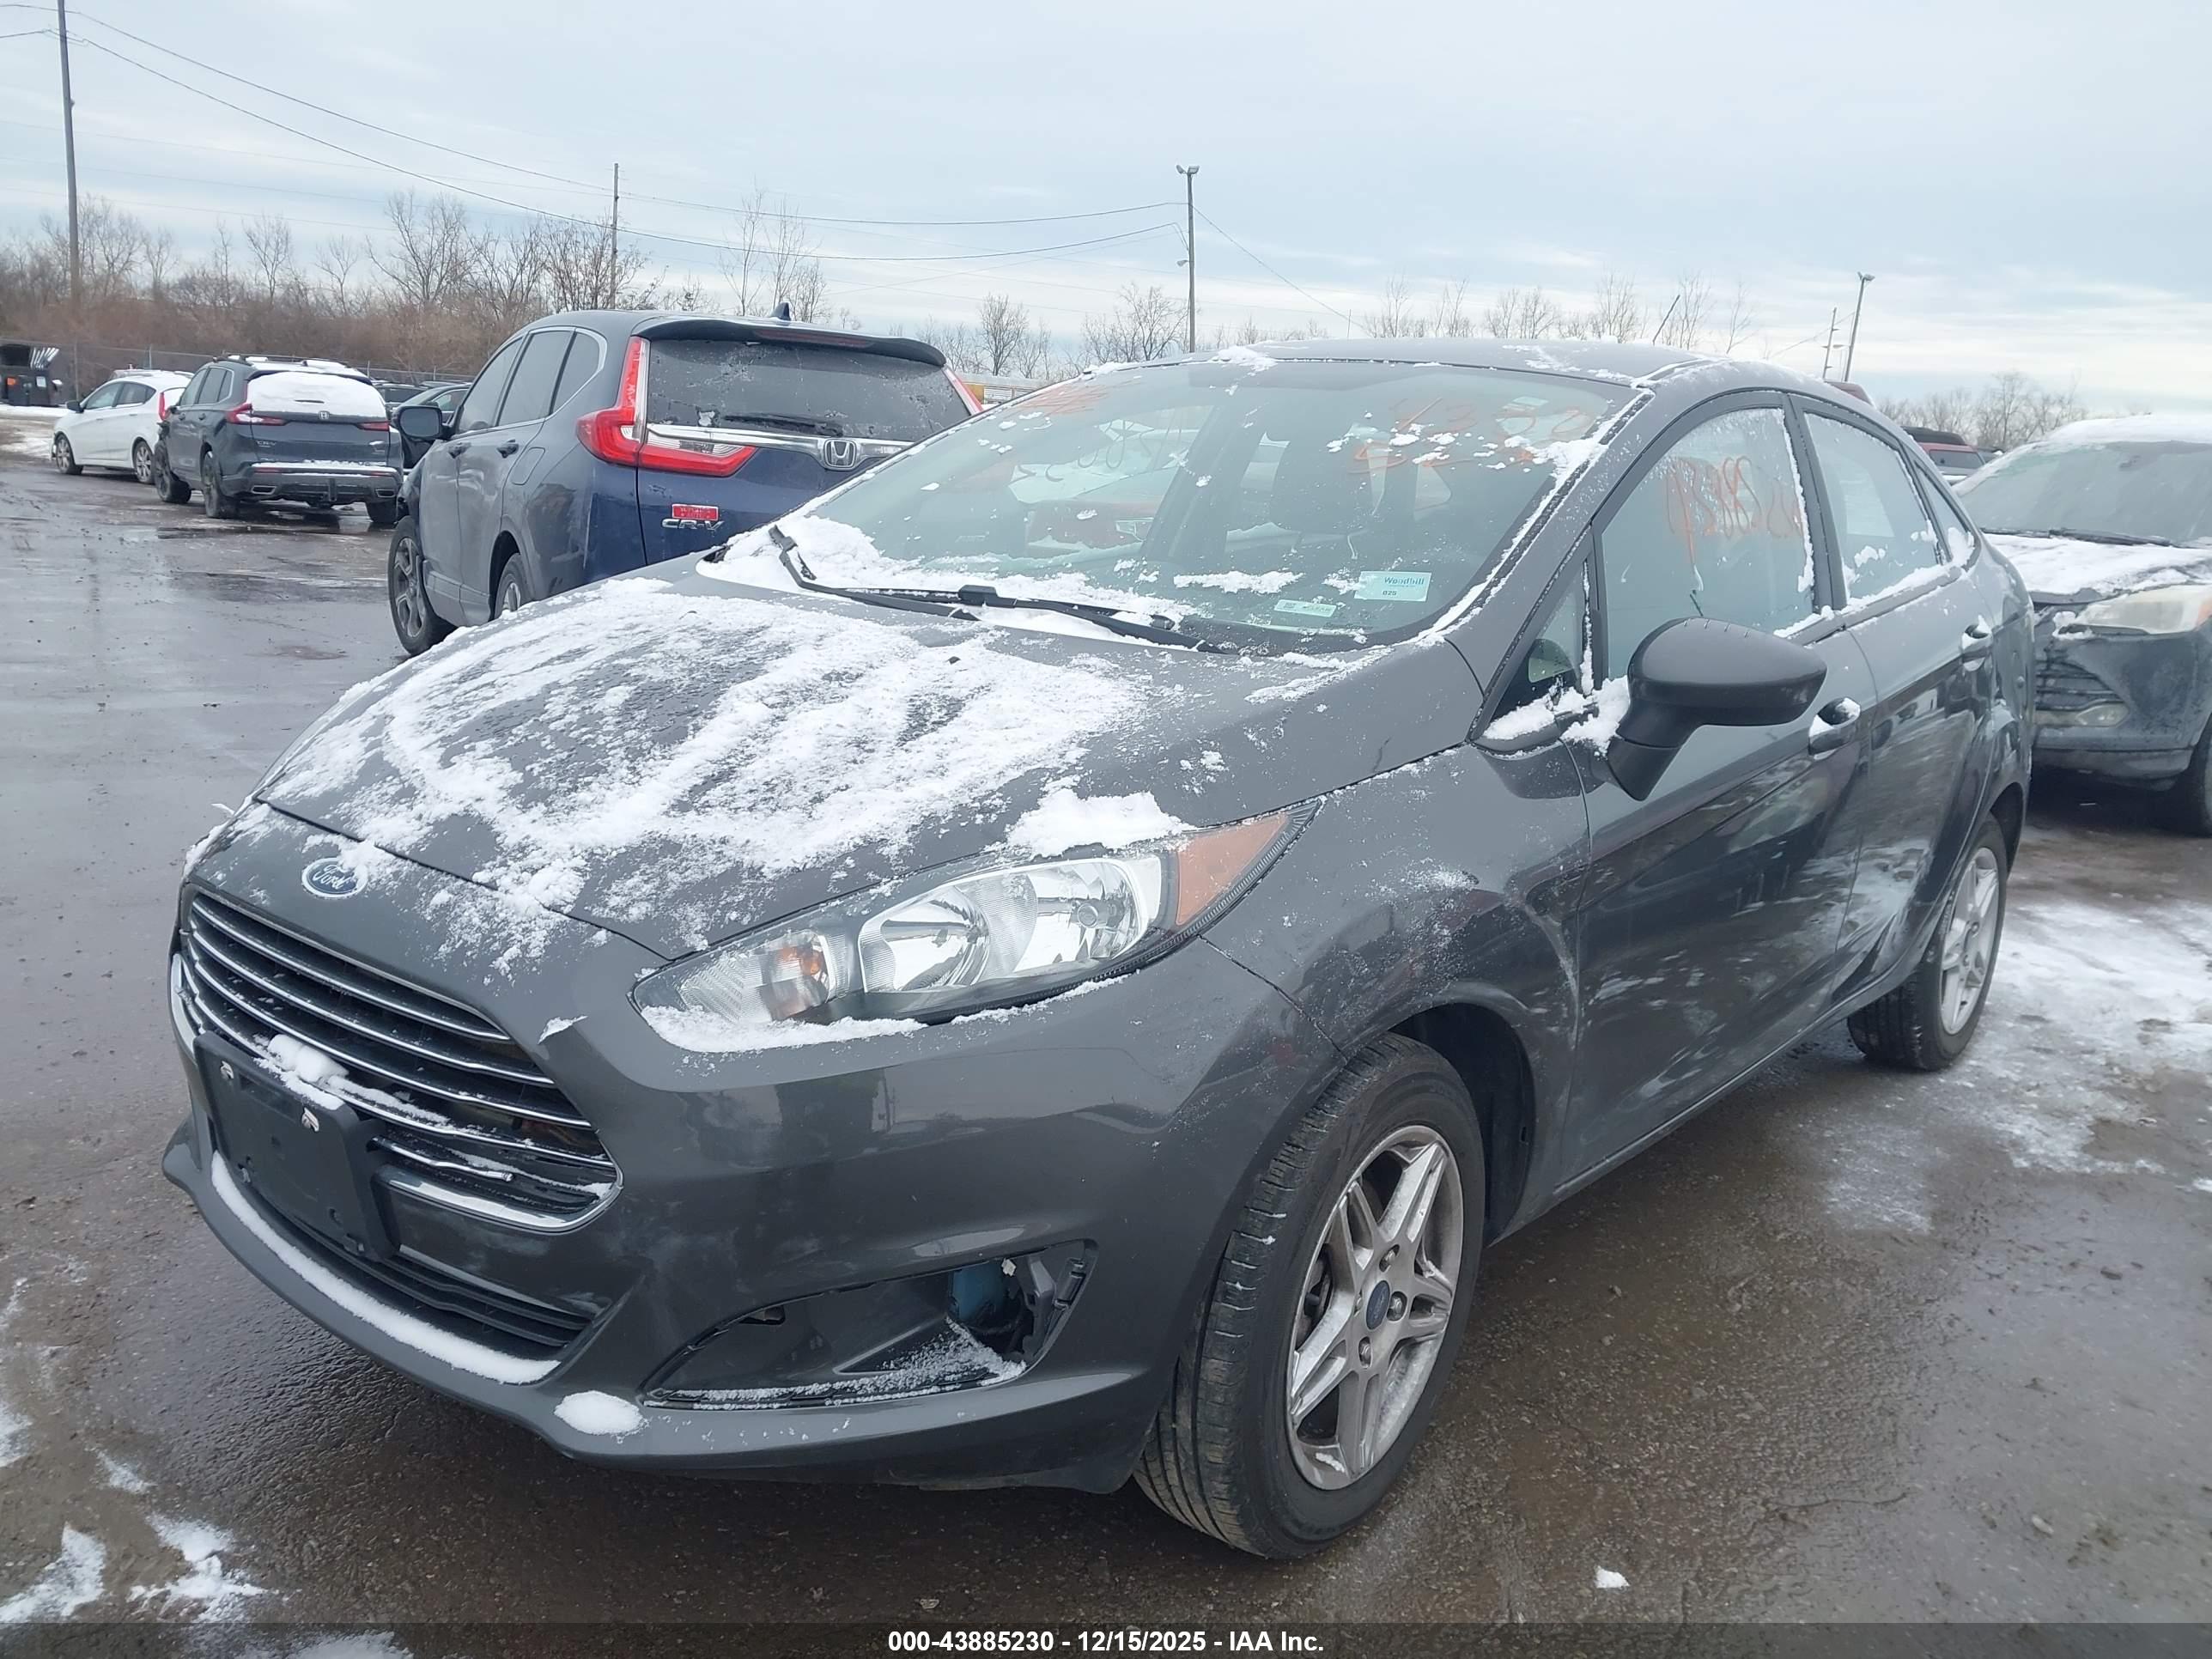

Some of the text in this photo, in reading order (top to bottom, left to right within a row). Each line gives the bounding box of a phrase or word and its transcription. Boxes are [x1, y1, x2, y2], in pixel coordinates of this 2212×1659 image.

[661, 518, 725, 531] CR-V
[1384, 576, 1425, 585] Woodhill
[313, 864, 352, 890] Ford
